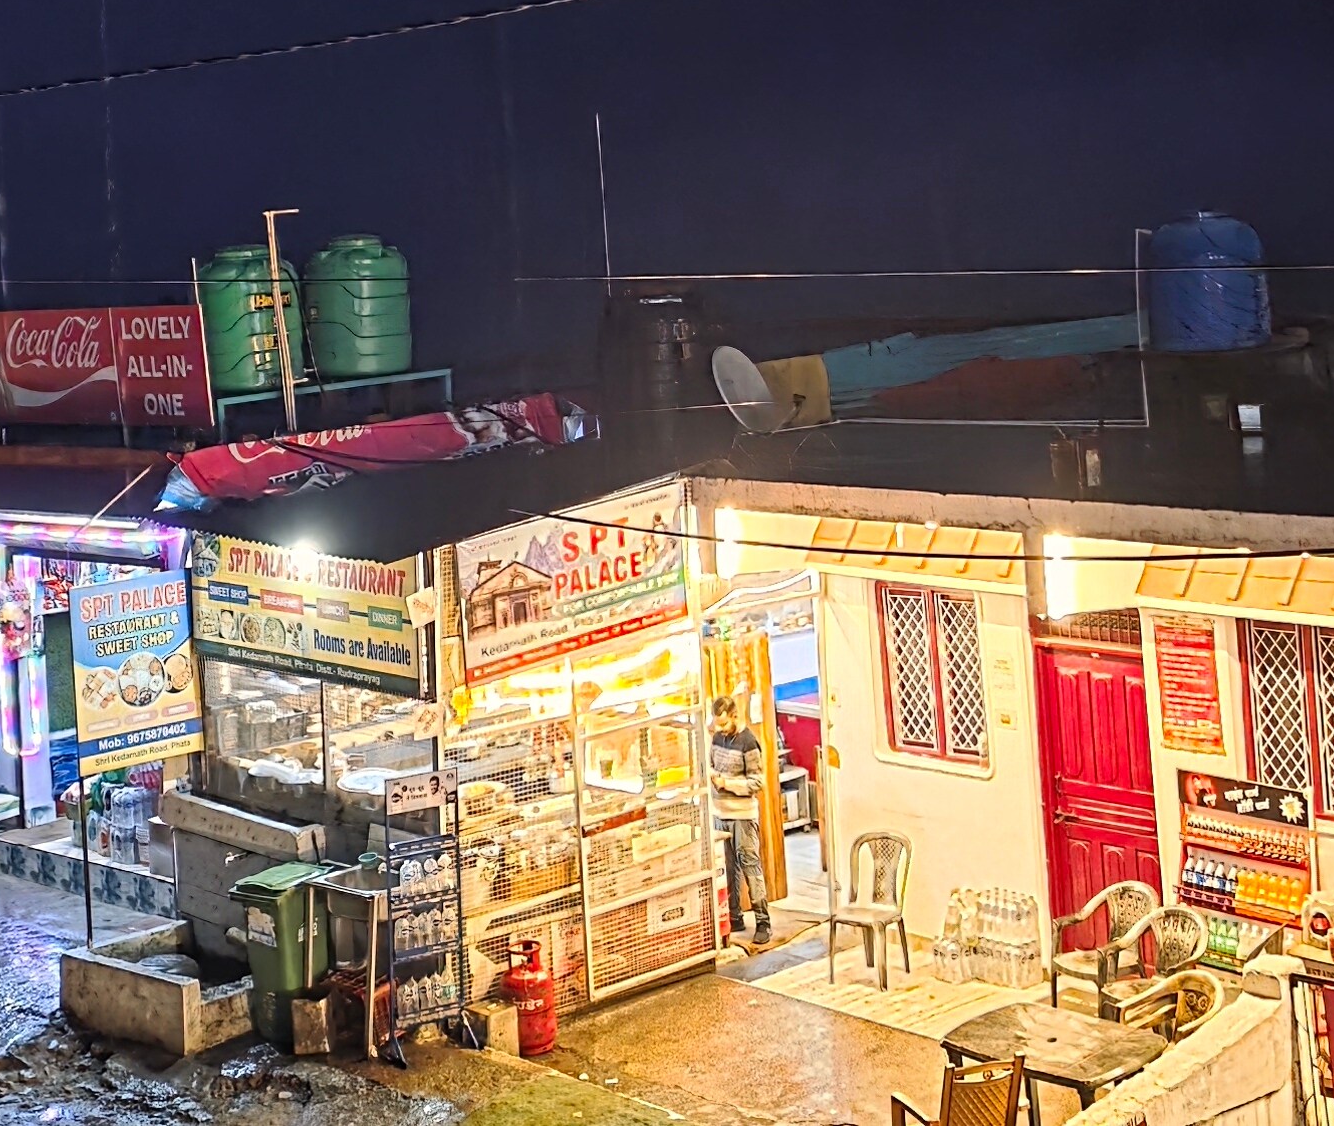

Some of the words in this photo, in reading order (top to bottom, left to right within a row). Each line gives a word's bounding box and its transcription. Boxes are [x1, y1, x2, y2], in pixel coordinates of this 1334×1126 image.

[120, 315, 191, 340] LOVELY
[5, 316, 103, 369] Coca-Cola
[127, 355, 193, 378] ALL-IN-
[144, 393, 186, 416] ONE
[228, 546, 250, 574] SPT
[318, 559, 406, 598] RESTAURANT
[554, 552, 643, 599] PALACE
[80, 594, 113, 622] SPT
[120, 580, 186, 613] PALACE
[210, 585, 229, 598] SWEET
[230, 588, 247, 600] SHOP
[89, 614, 167, 640] RESTAURANT
[170, 610, 180, 625] &
[372, 613, 397, 625] DINNER
[96, 636, 138, 657] SWEET
[141, 630, 174, 648] SHOP
[313, 629, 346, 654] Rooms
[348, 640, 364, 658] are
[367, 637, 411, 666] Available
[95, 756, 110, 766] Shri
[111, 747, 147, 763] Kedarnath
[99, 737, 125, 751] Mob:
